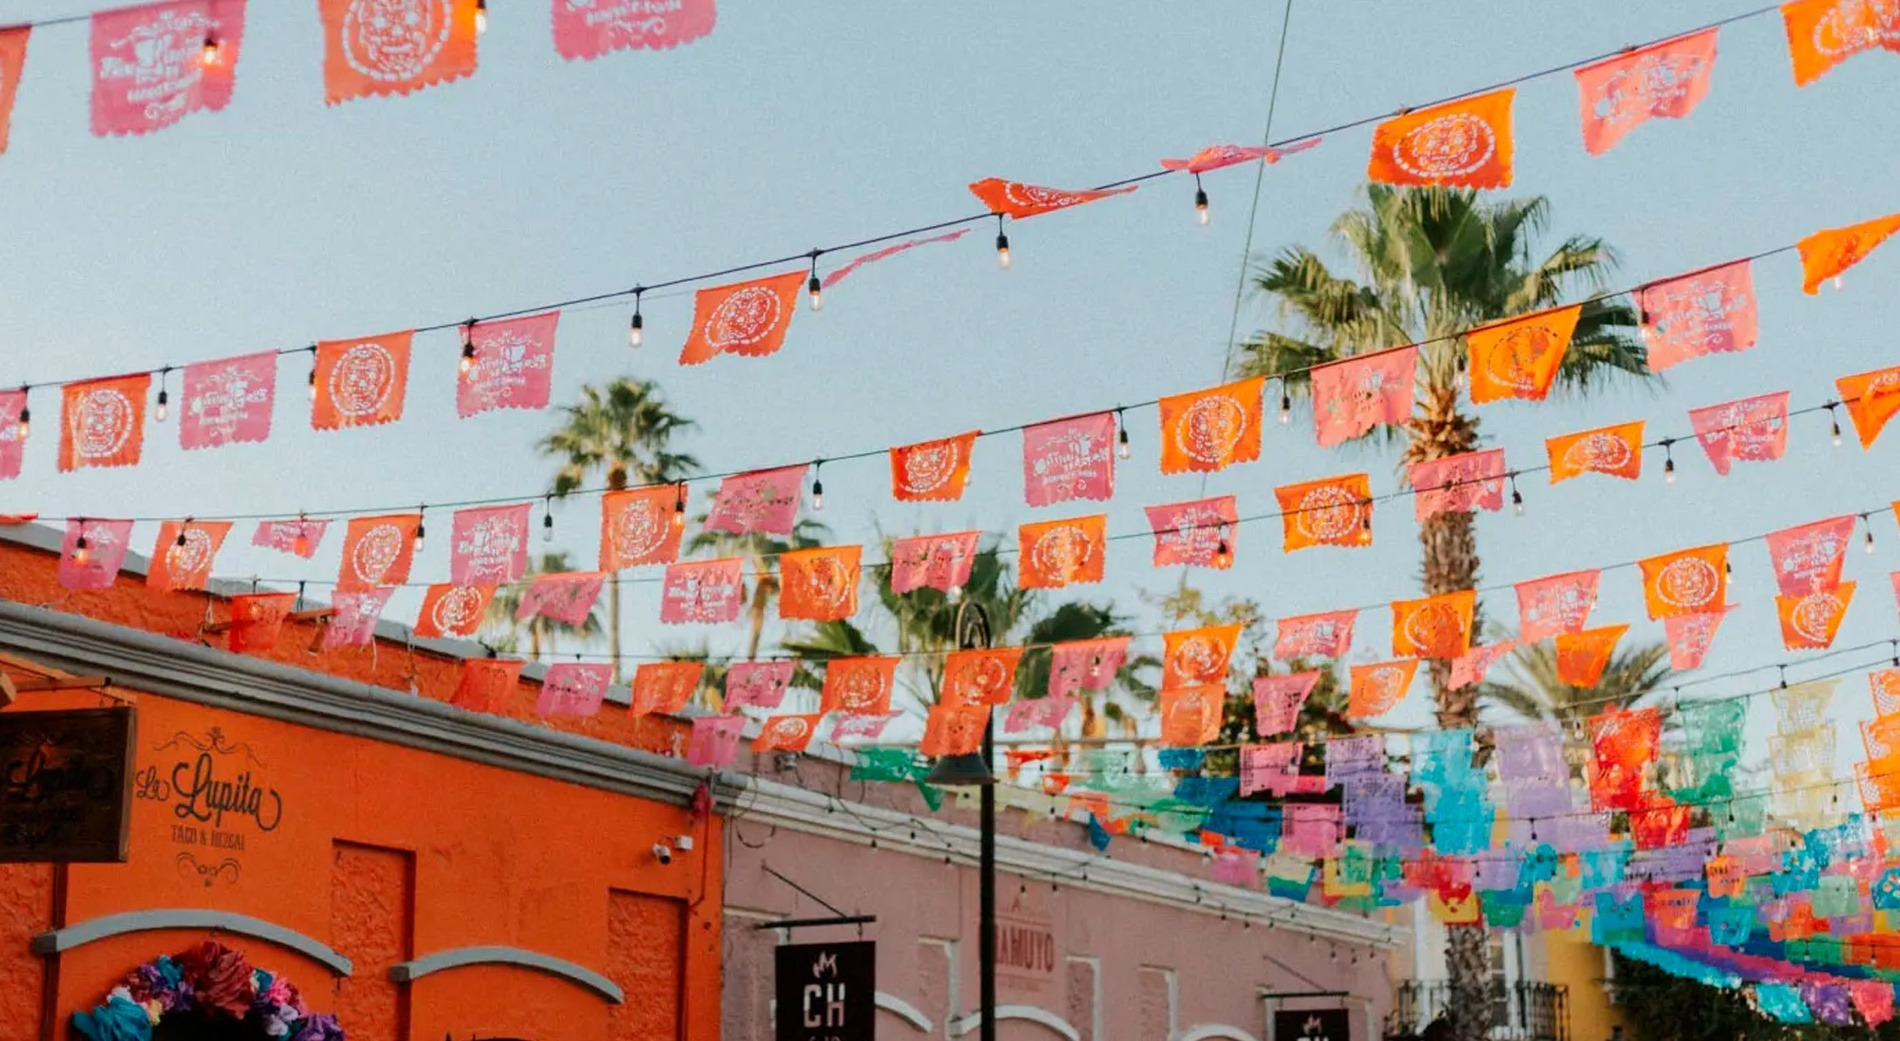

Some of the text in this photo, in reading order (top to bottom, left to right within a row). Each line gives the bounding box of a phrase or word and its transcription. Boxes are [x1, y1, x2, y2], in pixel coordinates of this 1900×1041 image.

[136, 765, 170, 802] La
[171, 752, 282, 831] Lupita
[979, 923, 1054, 972] AMUYO
[803, 982, 846, 1028] CH
